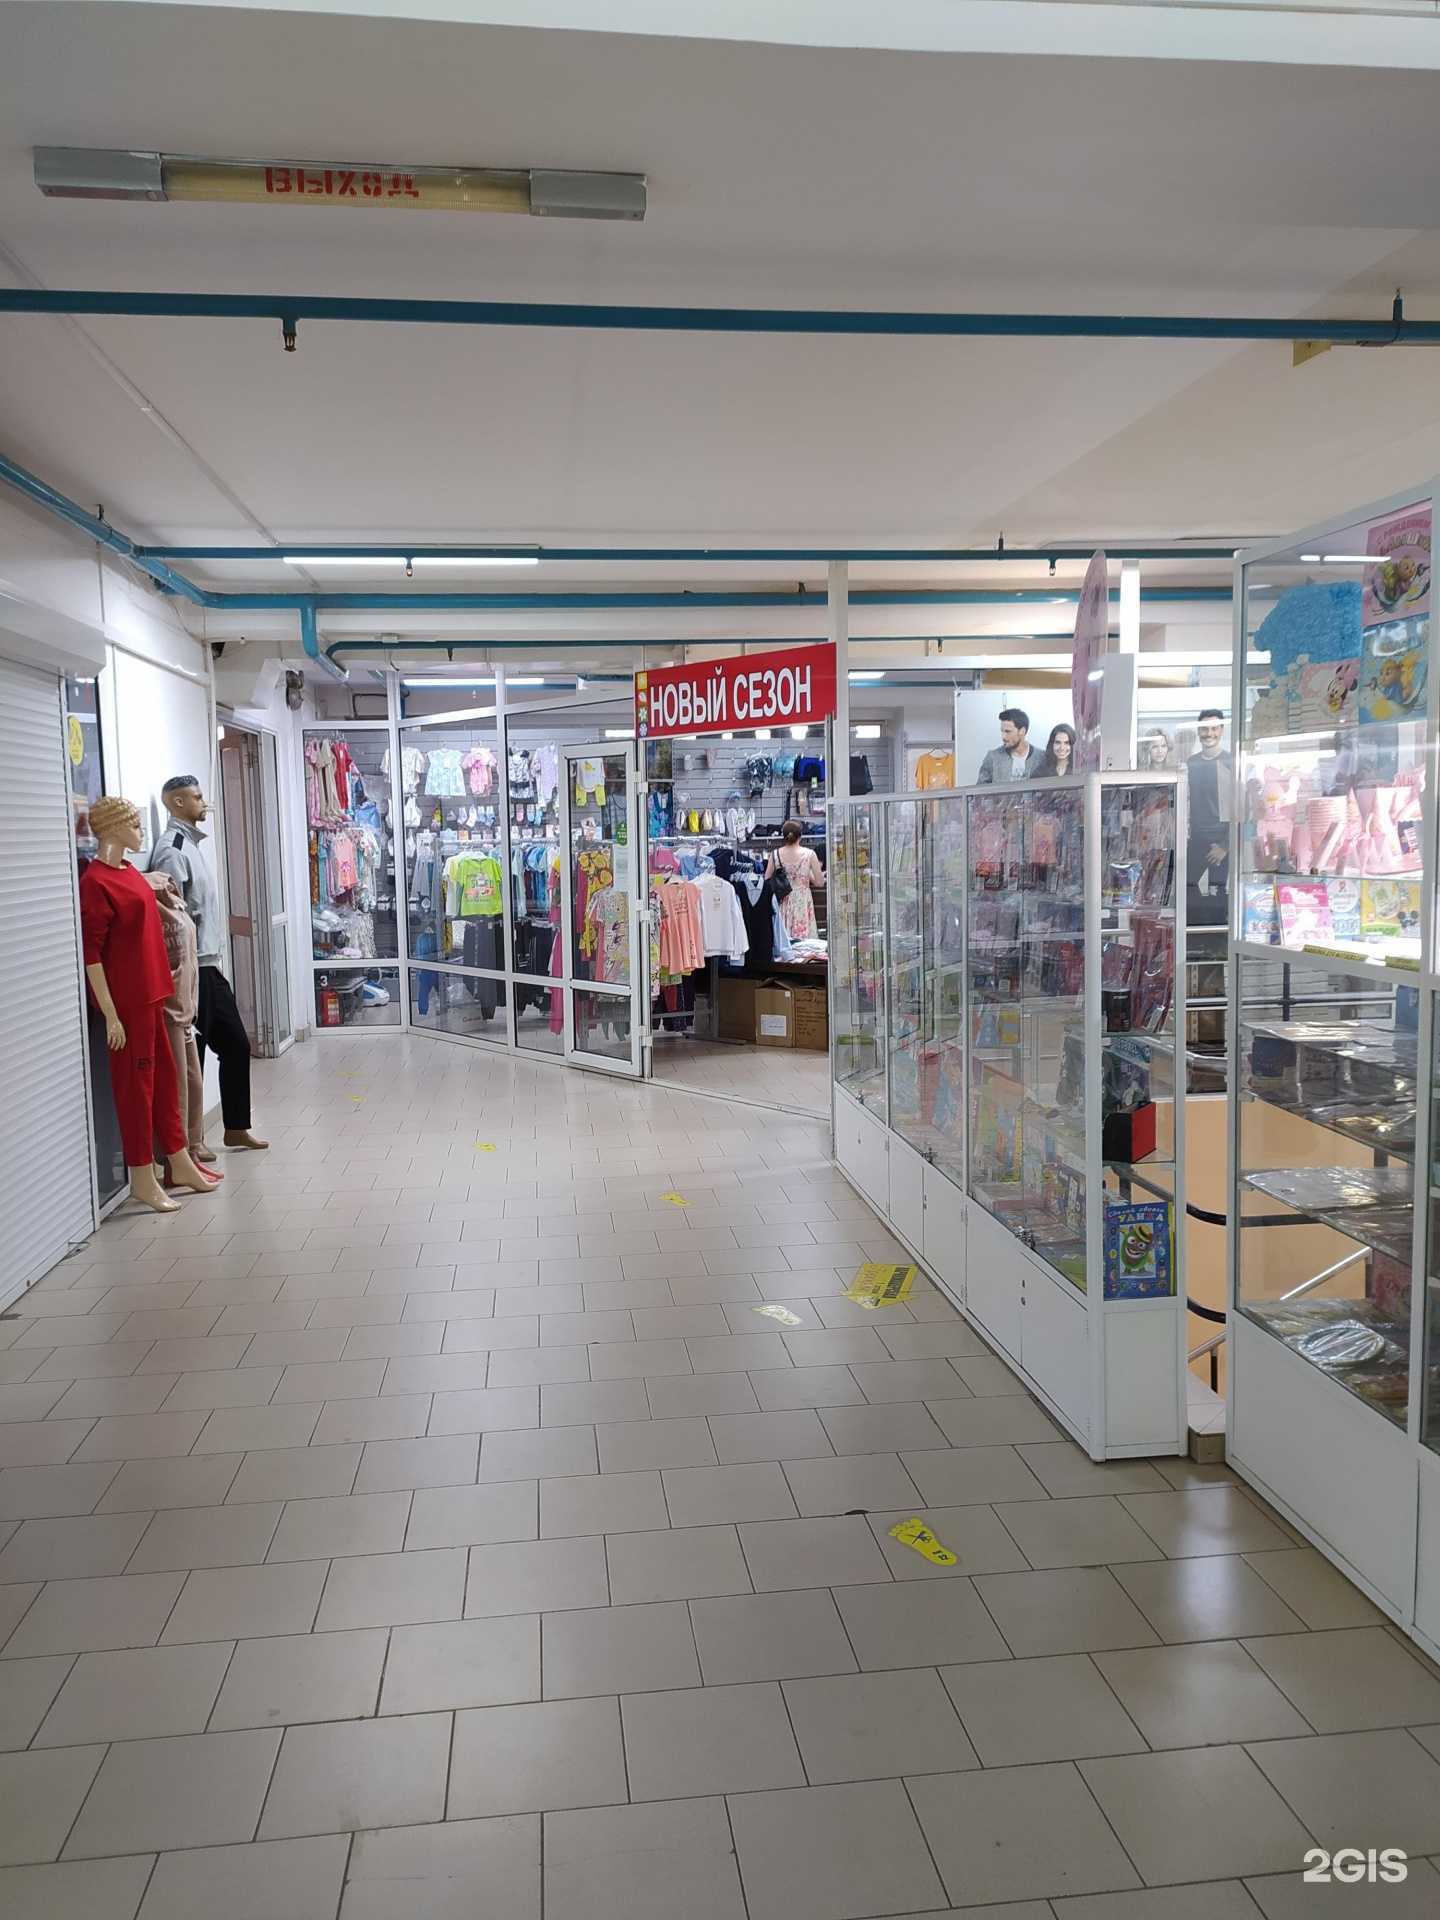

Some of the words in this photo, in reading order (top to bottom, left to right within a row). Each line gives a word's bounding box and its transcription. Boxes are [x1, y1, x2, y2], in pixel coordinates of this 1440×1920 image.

[265, 166, 419, 198] ВЫХОД
[650, 665, 727, 728] НОВЫЙ
[733, 664, 812, 720] СЕЗОН
